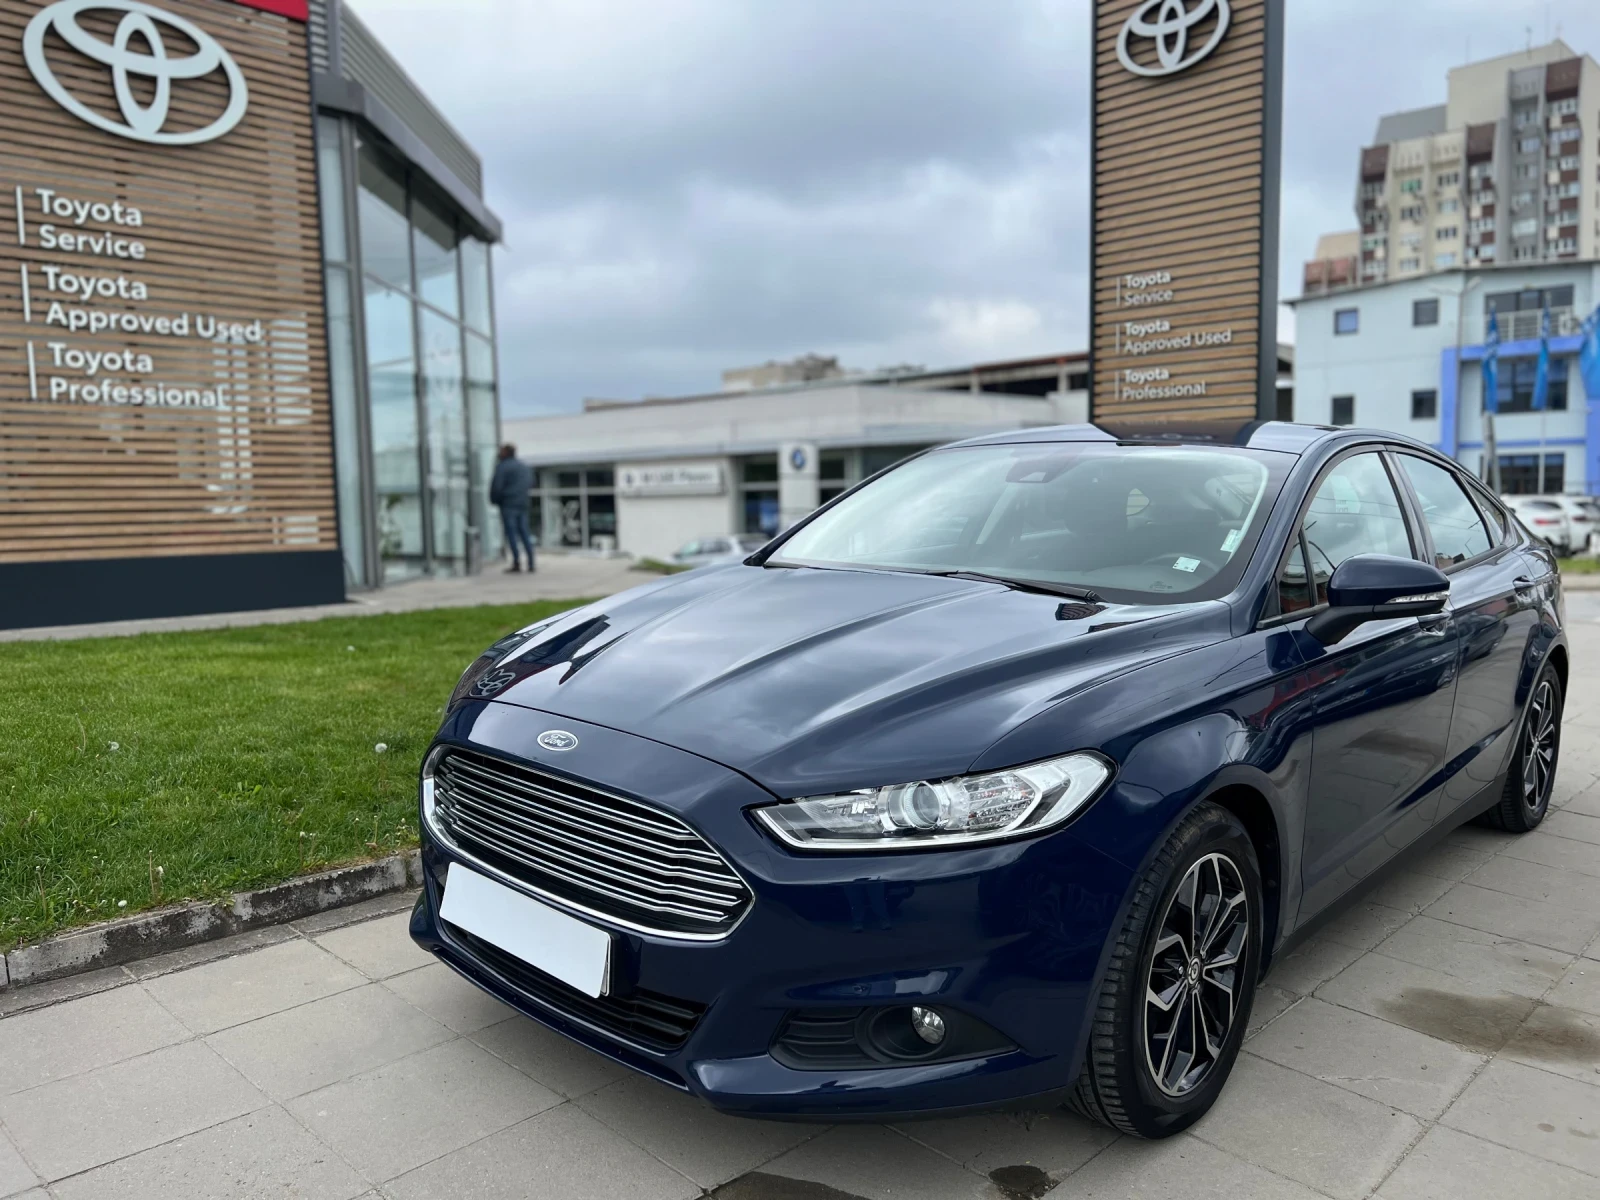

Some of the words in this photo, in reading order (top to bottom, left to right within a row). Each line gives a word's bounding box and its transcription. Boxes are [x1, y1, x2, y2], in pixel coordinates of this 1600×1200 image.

[36, 188, 143, 227] Toyota
[39, 225, 146, 260] Service
[41, 265, 148, 300] Toyota
[1124, 271, 1171, 289] Toyota
[1124, 289, 1173, 306] Service
[46, 302, 190, 334] Approved
[196, 315, 262, 343] Used
[1124, 320, 1170, 337] Toyota
[1124, 333, 1191, 355] Approved
[1195, 328, 1232, 345] Used
[48, 342, 154, 375] Toyota
[1122, 380, 1206, 400] Professional
[1124, 368, 1169, 384] Toyota
[50, 377, 226, 409] Professional
